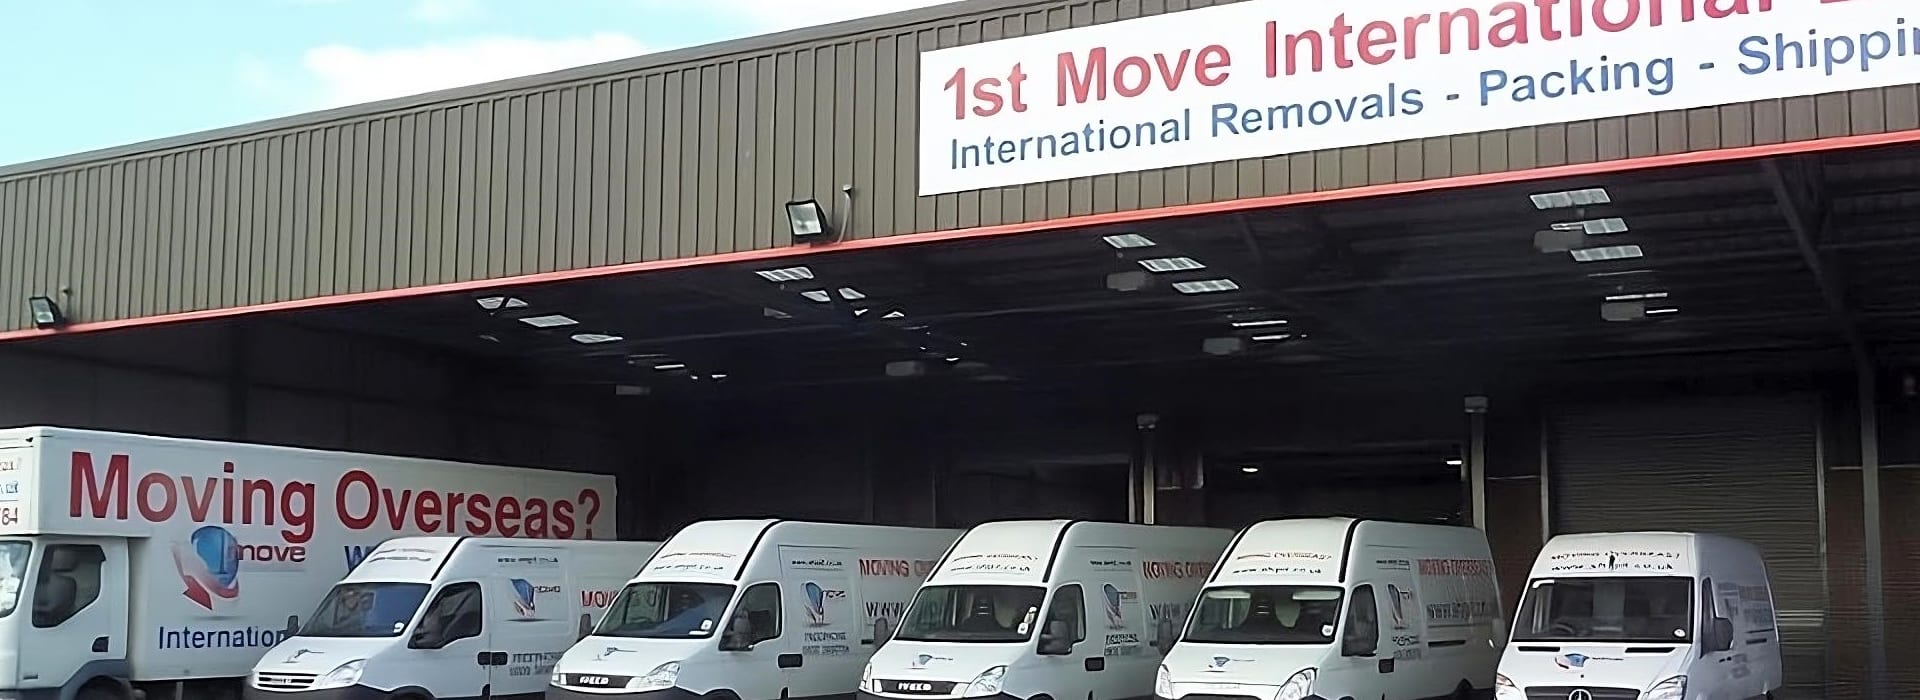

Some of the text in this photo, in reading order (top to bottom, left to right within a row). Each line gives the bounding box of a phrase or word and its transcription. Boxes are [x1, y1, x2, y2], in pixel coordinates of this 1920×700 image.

[944, 0, 1772, 120] 1st Move Internation
[951, 108, 1190, 170] International
[1211, 83, 1424, 137] Removals
[1480, 55, 1674, 106] Packing
[69, 451, 601, 544] Moving Overseas?
[236, 543, 306, 562] move
